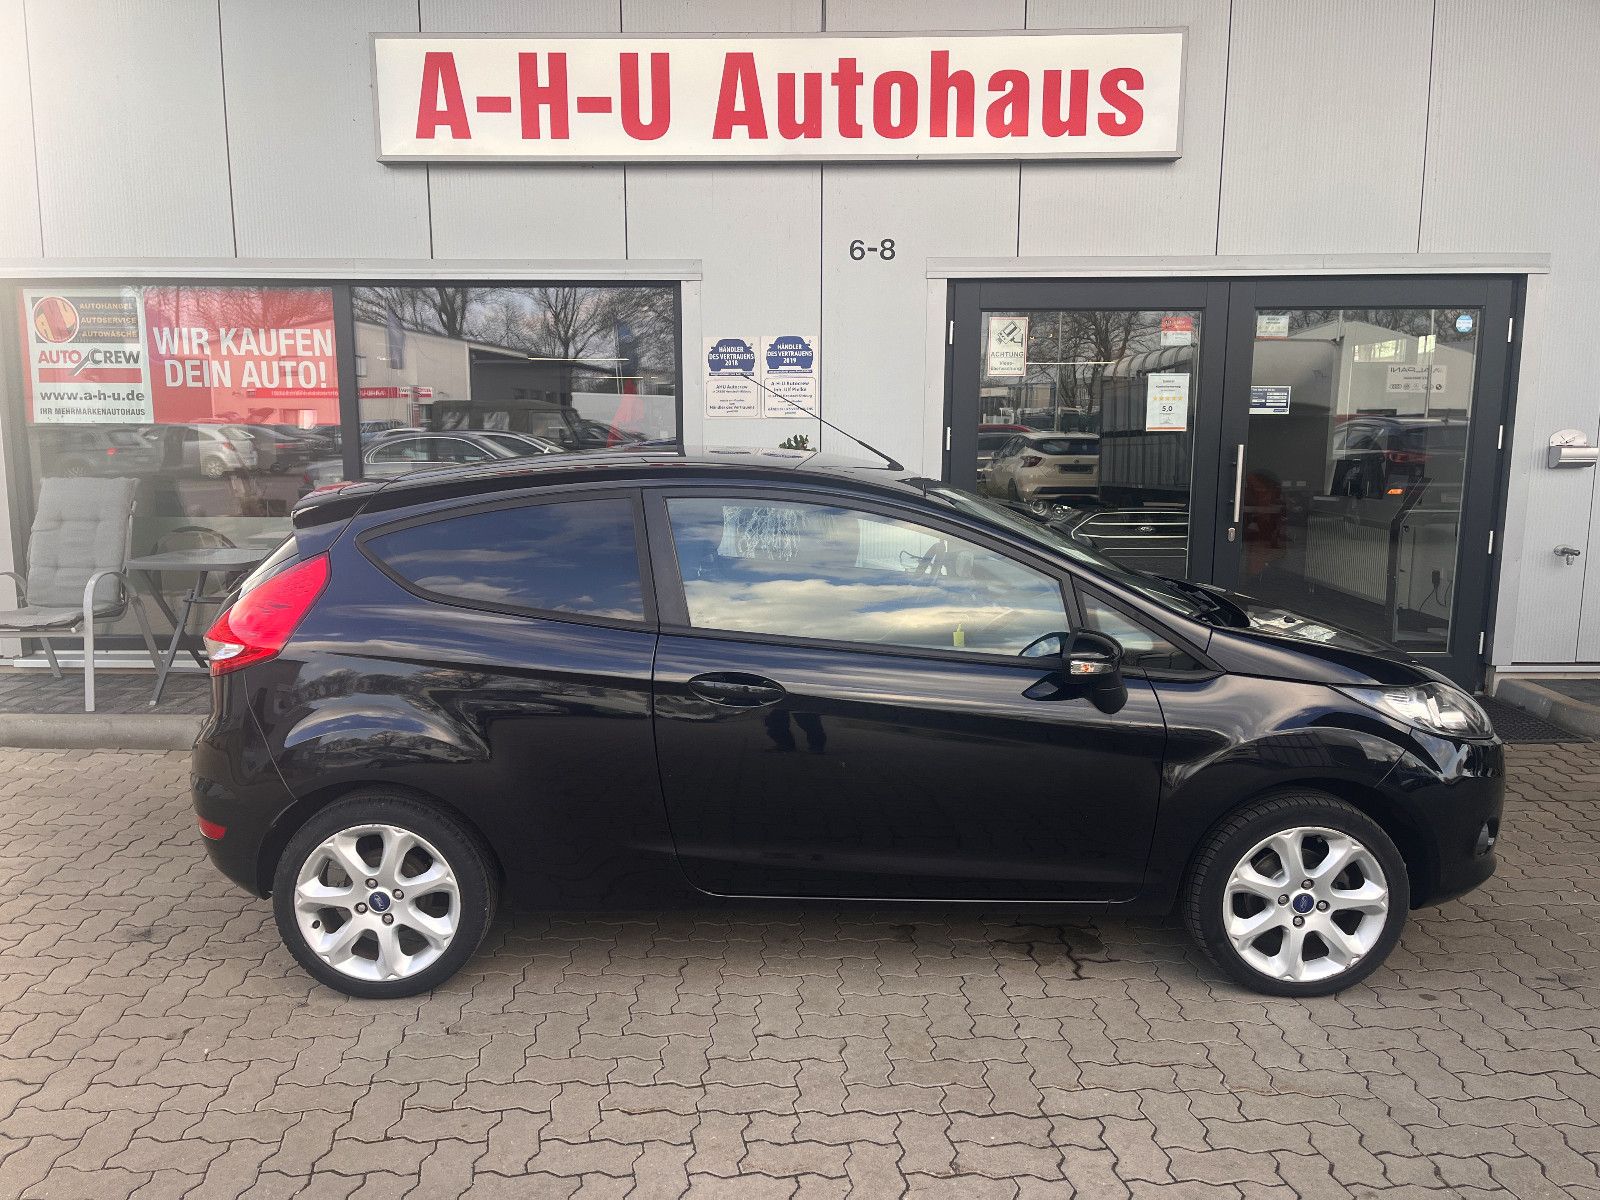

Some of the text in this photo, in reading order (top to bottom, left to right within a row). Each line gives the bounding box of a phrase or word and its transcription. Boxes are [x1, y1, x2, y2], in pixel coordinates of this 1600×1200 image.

[415, 50, 1145, 140] A-H-U Autohaus
[849, 238, 896, 261] 6-8
[79, 302, 133, 311] AUTOHANDEL
[80, 316, 137, 325] AUTOSERVICE
[152, 327, 333, 357] WIR KAUFEN
[38, 349, 141, 365] AUTO CREW
[164, 359, 328, 389] DEIN AUTO!
[39, 389, 145, 401] www.a-h-u.de
[40, 407, 146, 417] IHR MEHRMARKENAUTOHAUS
